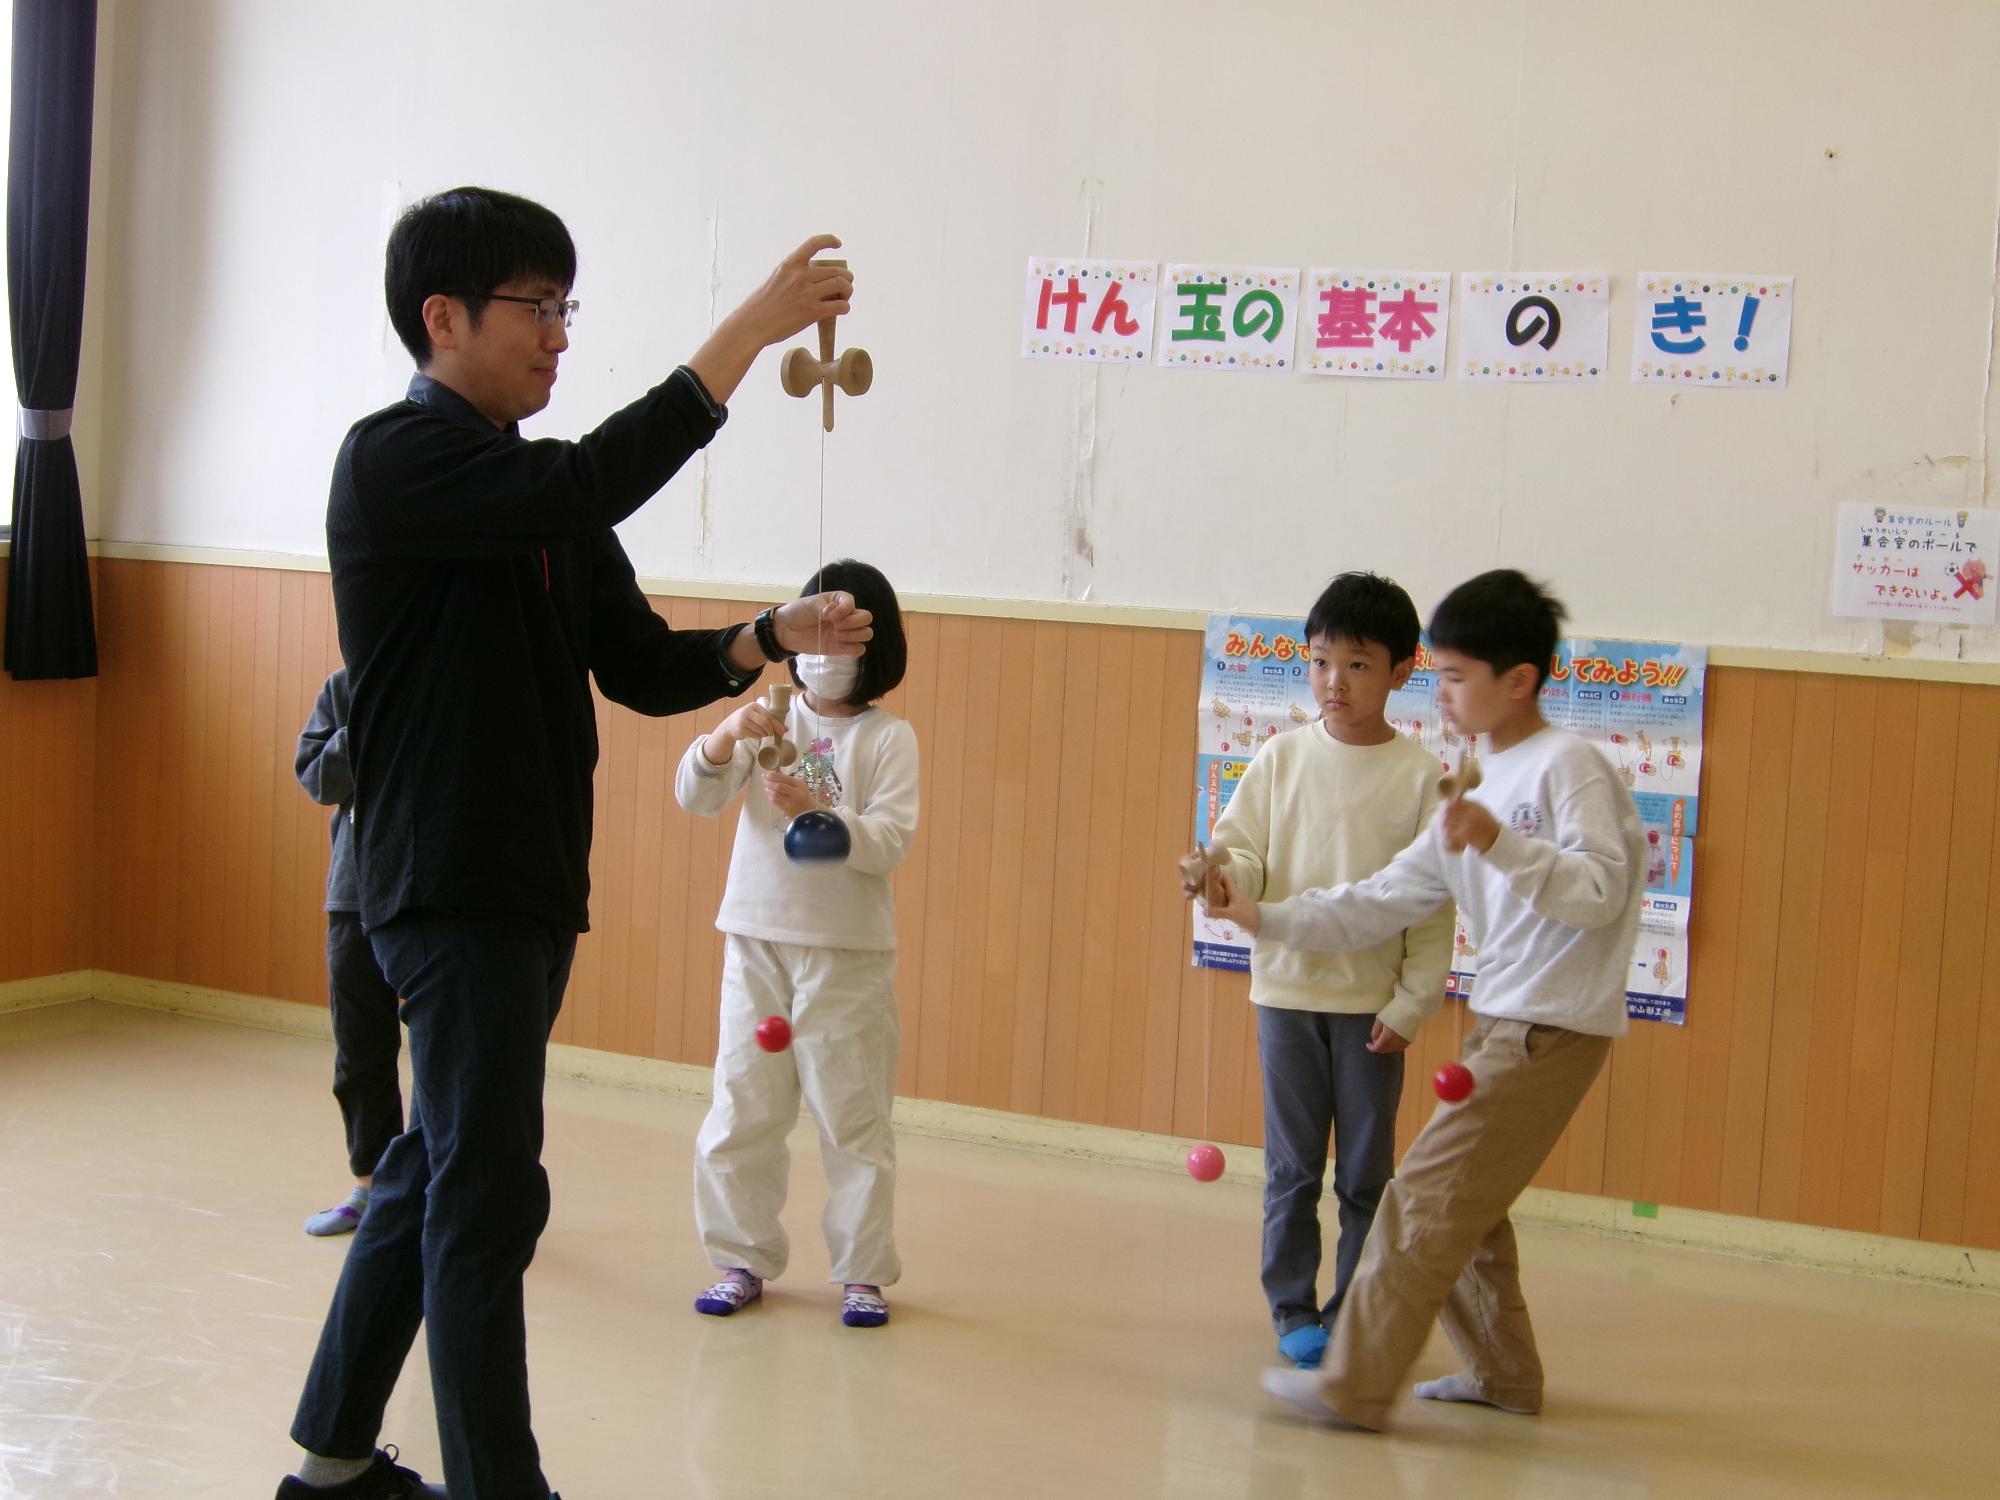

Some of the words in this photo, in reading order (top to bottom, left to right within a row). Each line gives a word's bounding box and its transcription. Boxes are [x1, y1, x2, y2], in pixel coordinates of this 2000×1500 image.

[1862, 534, 1977, 552] 集合室のボールで
[1853, 562, 1920, 577] サッカーは
[1874, 584, 1948, 602] できないよ。
